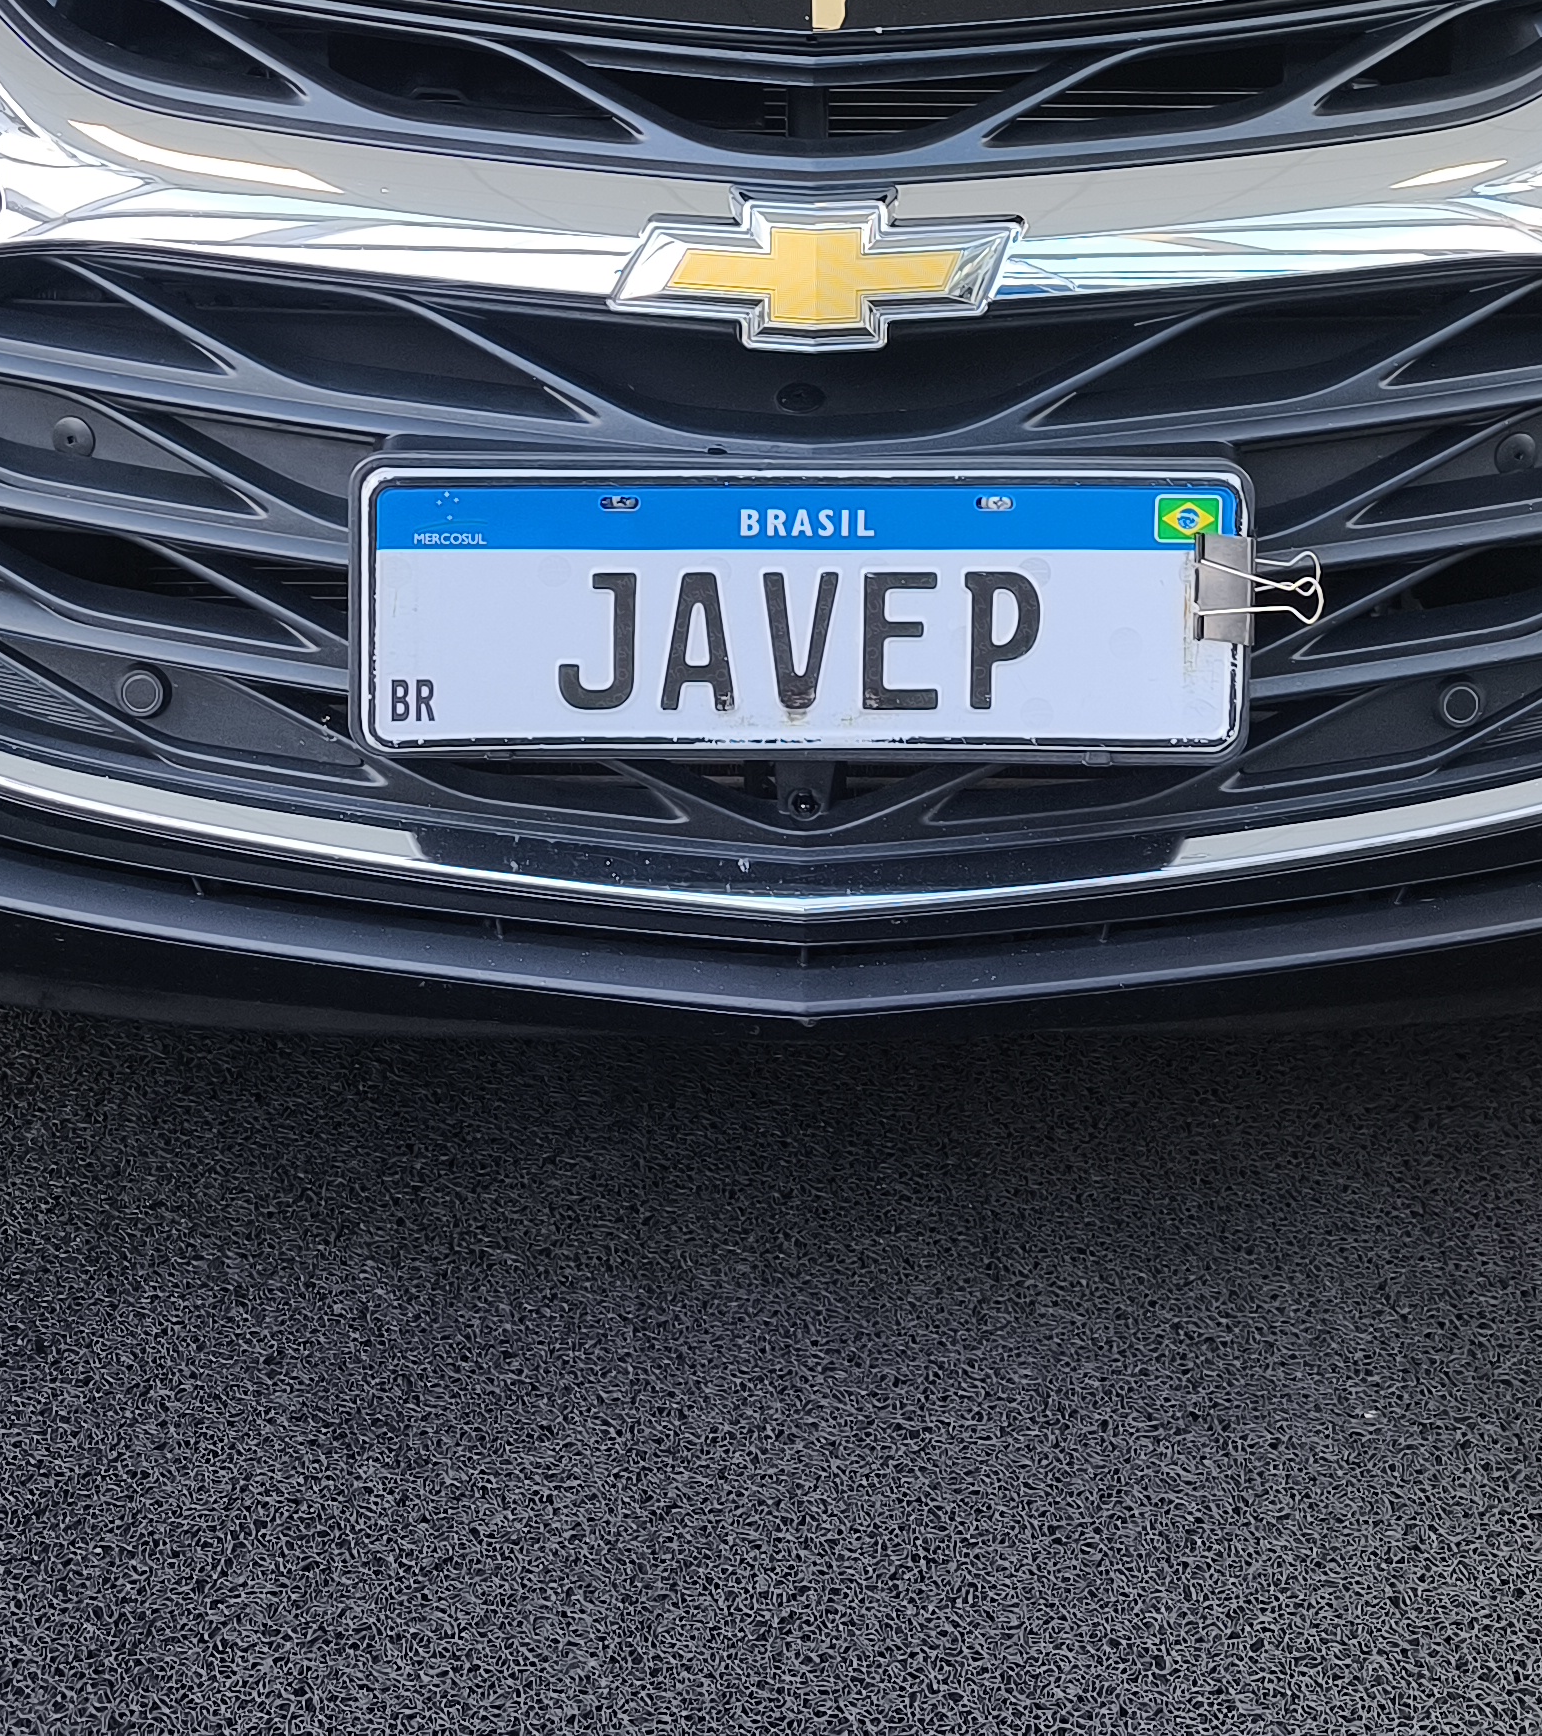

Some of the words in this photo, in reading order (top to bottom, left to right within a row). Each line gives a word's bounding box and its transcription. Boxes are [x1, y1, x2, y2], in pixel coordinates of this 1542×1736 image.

[413, 532, 488, 545] MERCOSUL
[739, 508, 875, 538] BRASIL
[557, 570, 1042, 713] JAVEP
[390, 679, 436, 722] BR
